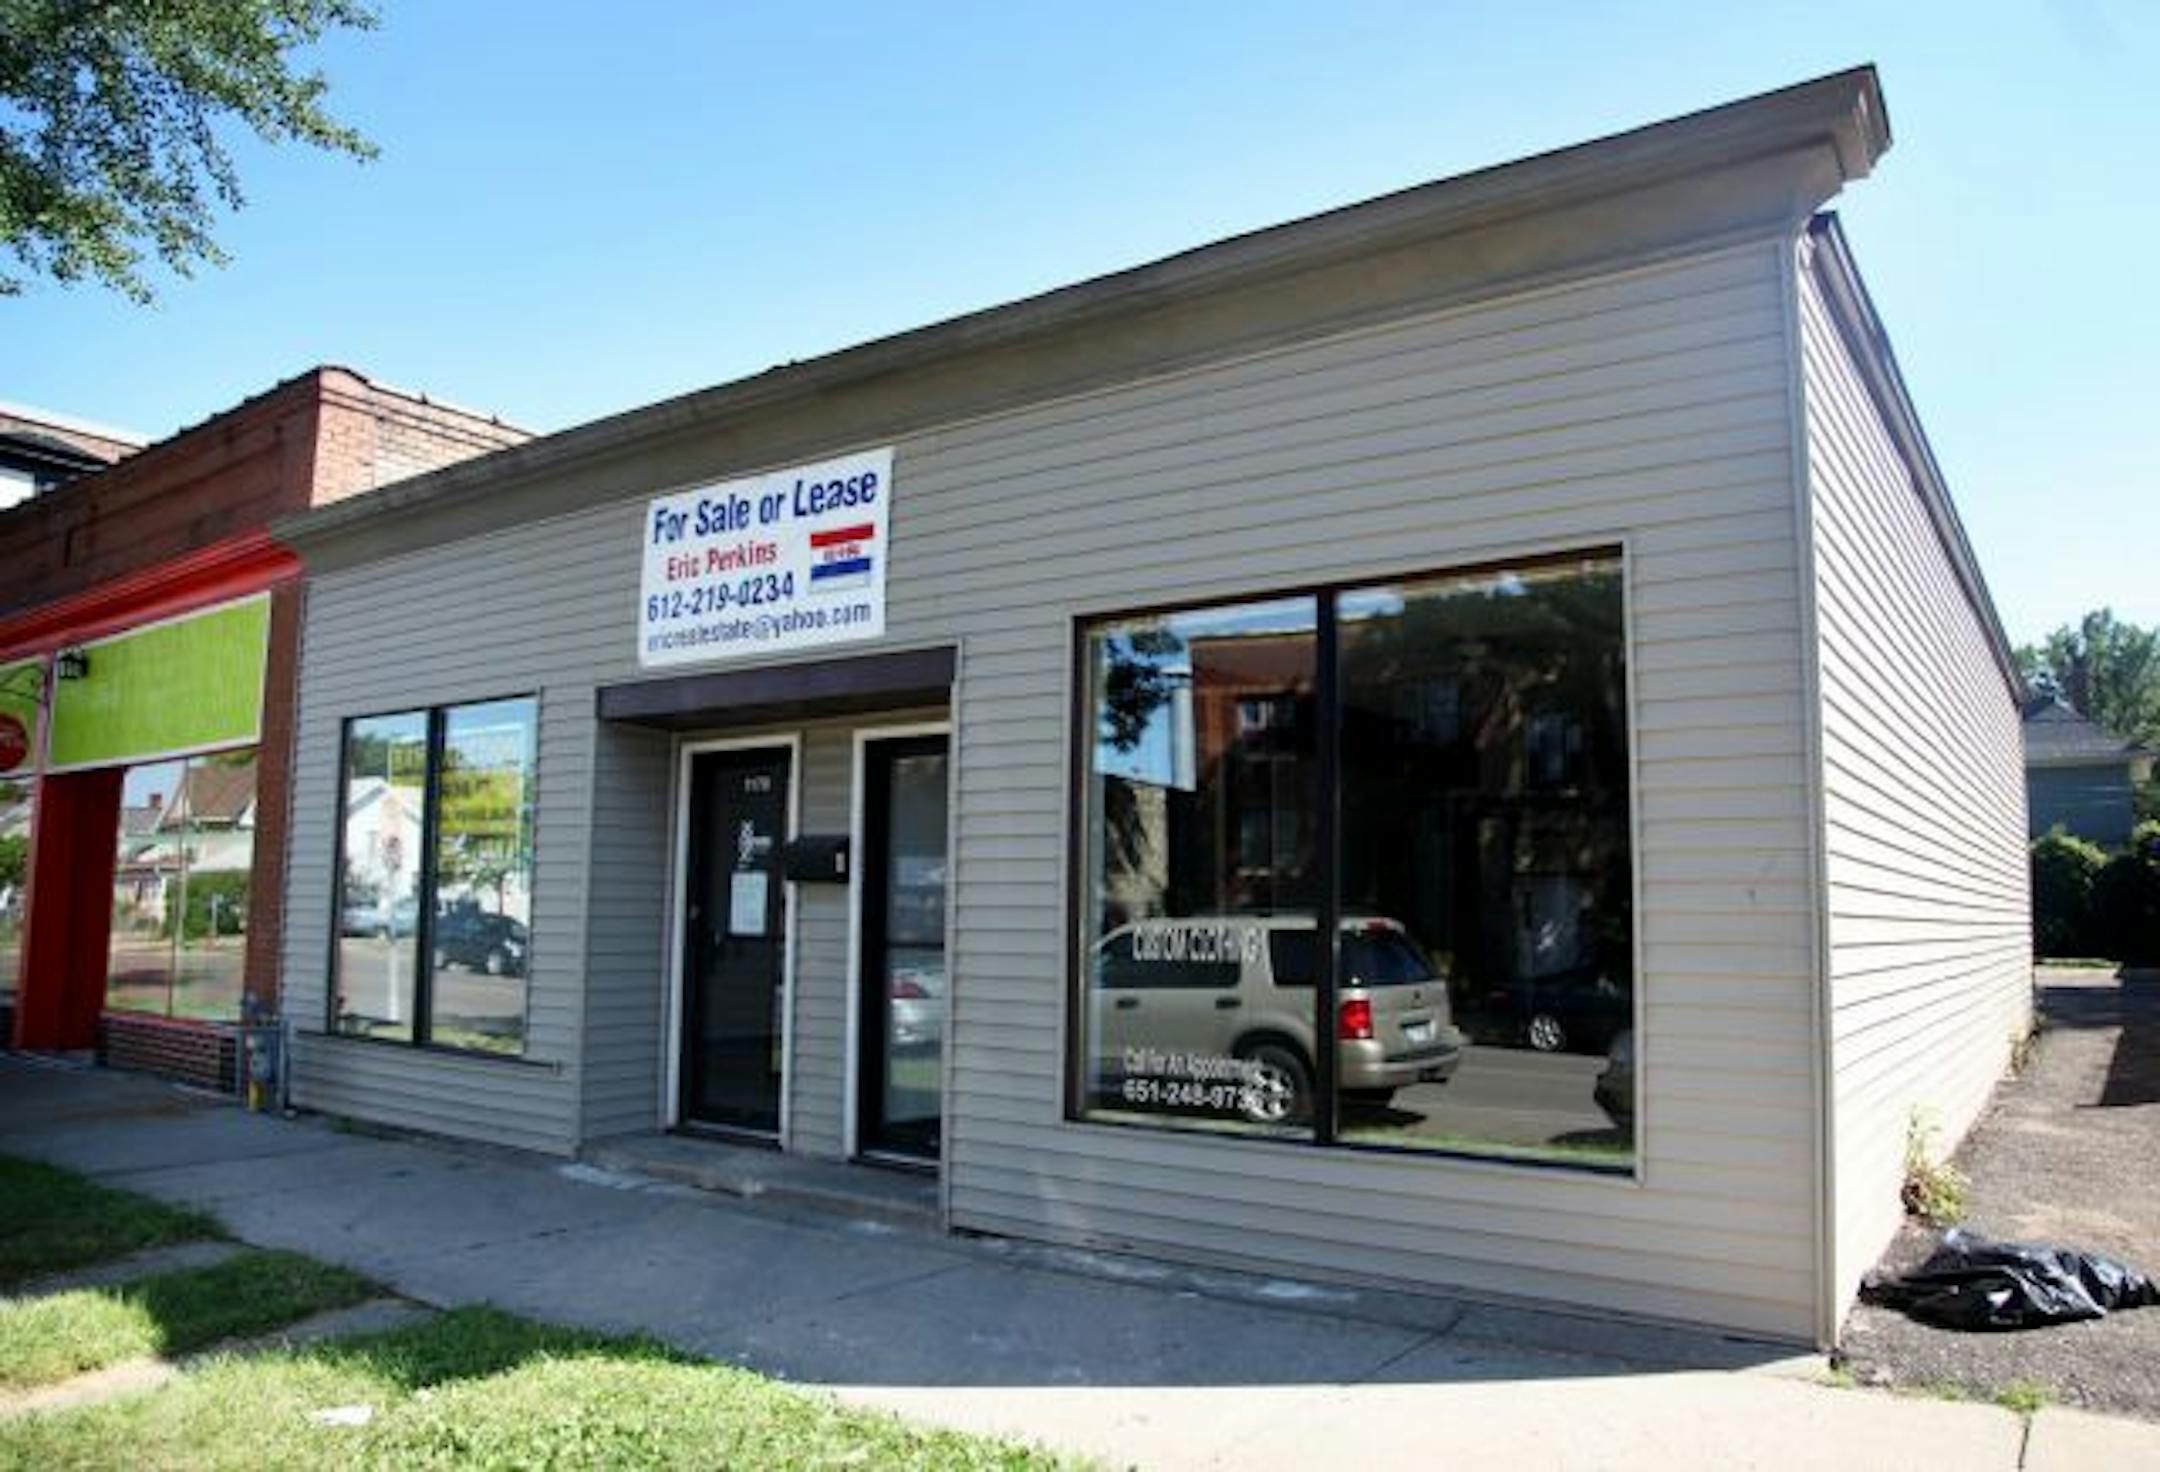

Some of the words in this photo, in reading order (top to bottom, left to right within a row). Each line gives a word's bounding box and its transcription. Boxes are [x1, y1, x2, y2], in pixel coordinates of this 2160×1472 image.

[652, 507, 688, 544] For
[695, 493, 750, 536] Sale
[760, 491, 787, 524] or
[793, 471, 878, 516] Lease
[667, 554, 699, 581] Eric
[706, 540, 777, 574] Perkins
[648, 571, 794, 622] 612-219-0234
